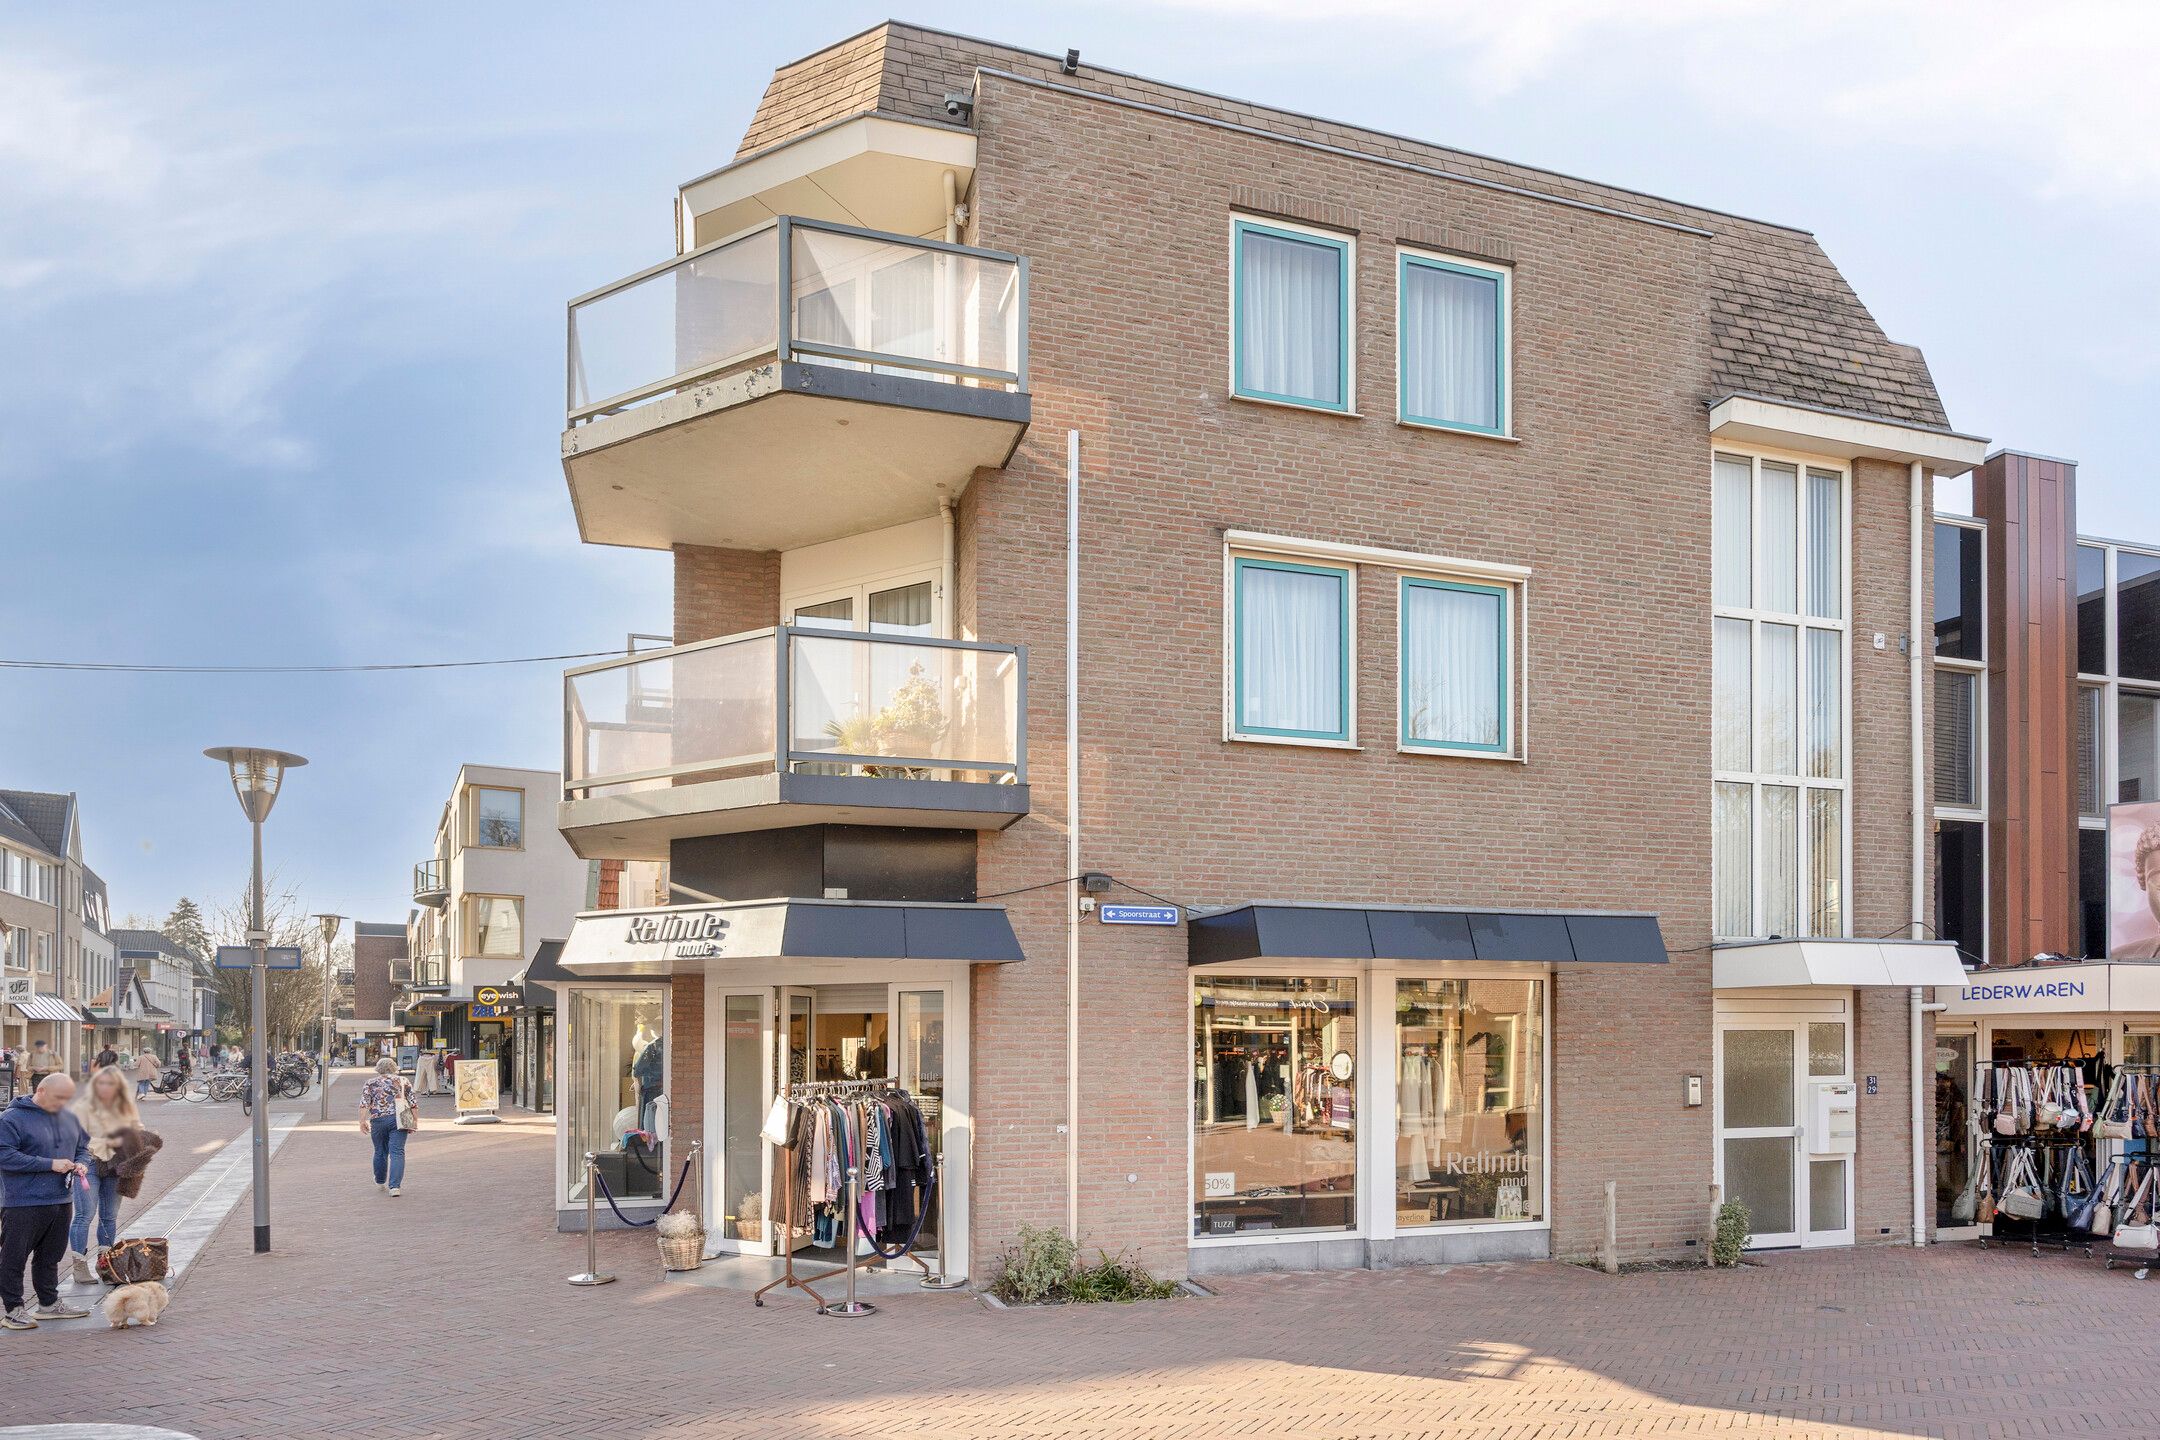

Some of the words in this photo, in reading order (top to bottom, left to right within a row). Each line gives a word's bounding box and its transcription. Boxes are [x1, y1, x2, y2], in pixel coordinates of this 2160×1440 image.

[1119, 910, 1161, 919] Spoorstraat
[625, 912, 723, 943] Relinde
[675, 942, 716, 958] mode
[480, 993, 497, 1001] eye
[498, 991, 519, 999] wish
[1962, 981, 2085, 1001] LEDERWAREN
[1867, 1086, 1876, 1094] 29
[1447, 1150, 1533, 1175] Relinde
[1205, 1178, 1231, 1190] 50%
[1213, 1221, 1234, 1229] TUZZI
